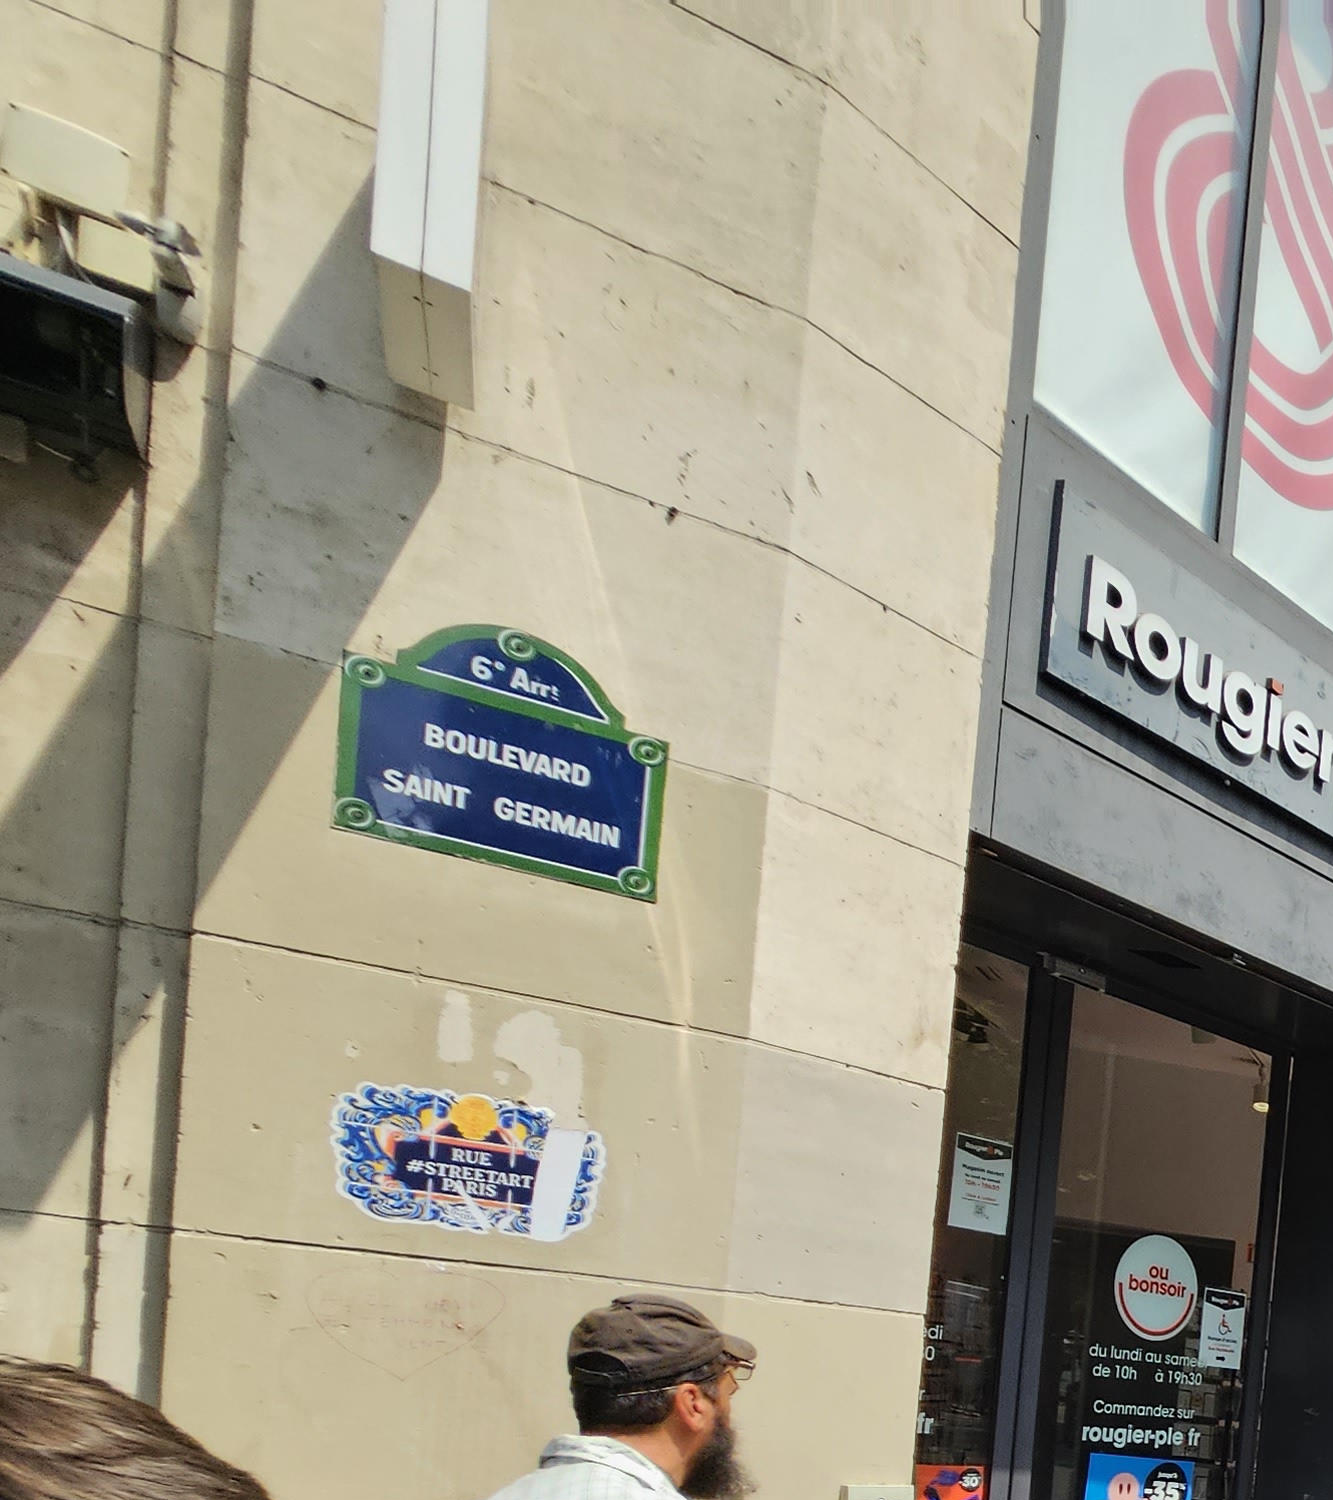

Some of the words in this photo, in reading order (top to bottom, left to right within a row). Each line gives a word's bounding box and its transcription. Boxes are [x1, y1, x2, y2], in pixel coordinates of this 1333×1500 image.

[423, 722, 591, 788] BOULEVARD
[382, 768, 472, 810] SAINT
[493, 797, 621, 849] GERMAIN
[451, 1147, 493, 1167] RUE
[405, 1159, 534, 1189] #STREETART
[442, 1178, 498, 1198] PARIS
[1149, 1265, 1169, 1280] ou
[1128, 1274, 1187, 1298] bonsoir
[1089, 1343, 1107, 1358] du
[1110, 1345, 1143, 1362] lundi
[1145, 1351, 1162, 1364] au
[1092, 1364, 1111, 1378] de
[1115, 1365, 1137, 1381] 10h
[1155, 1369, 1164, 1383] à
[1168, 1371, 1202, 1386] 19h30
[1093, 1400, 1175, 1418] Commandez
[1177, 1406, 1195, 1419] sur
